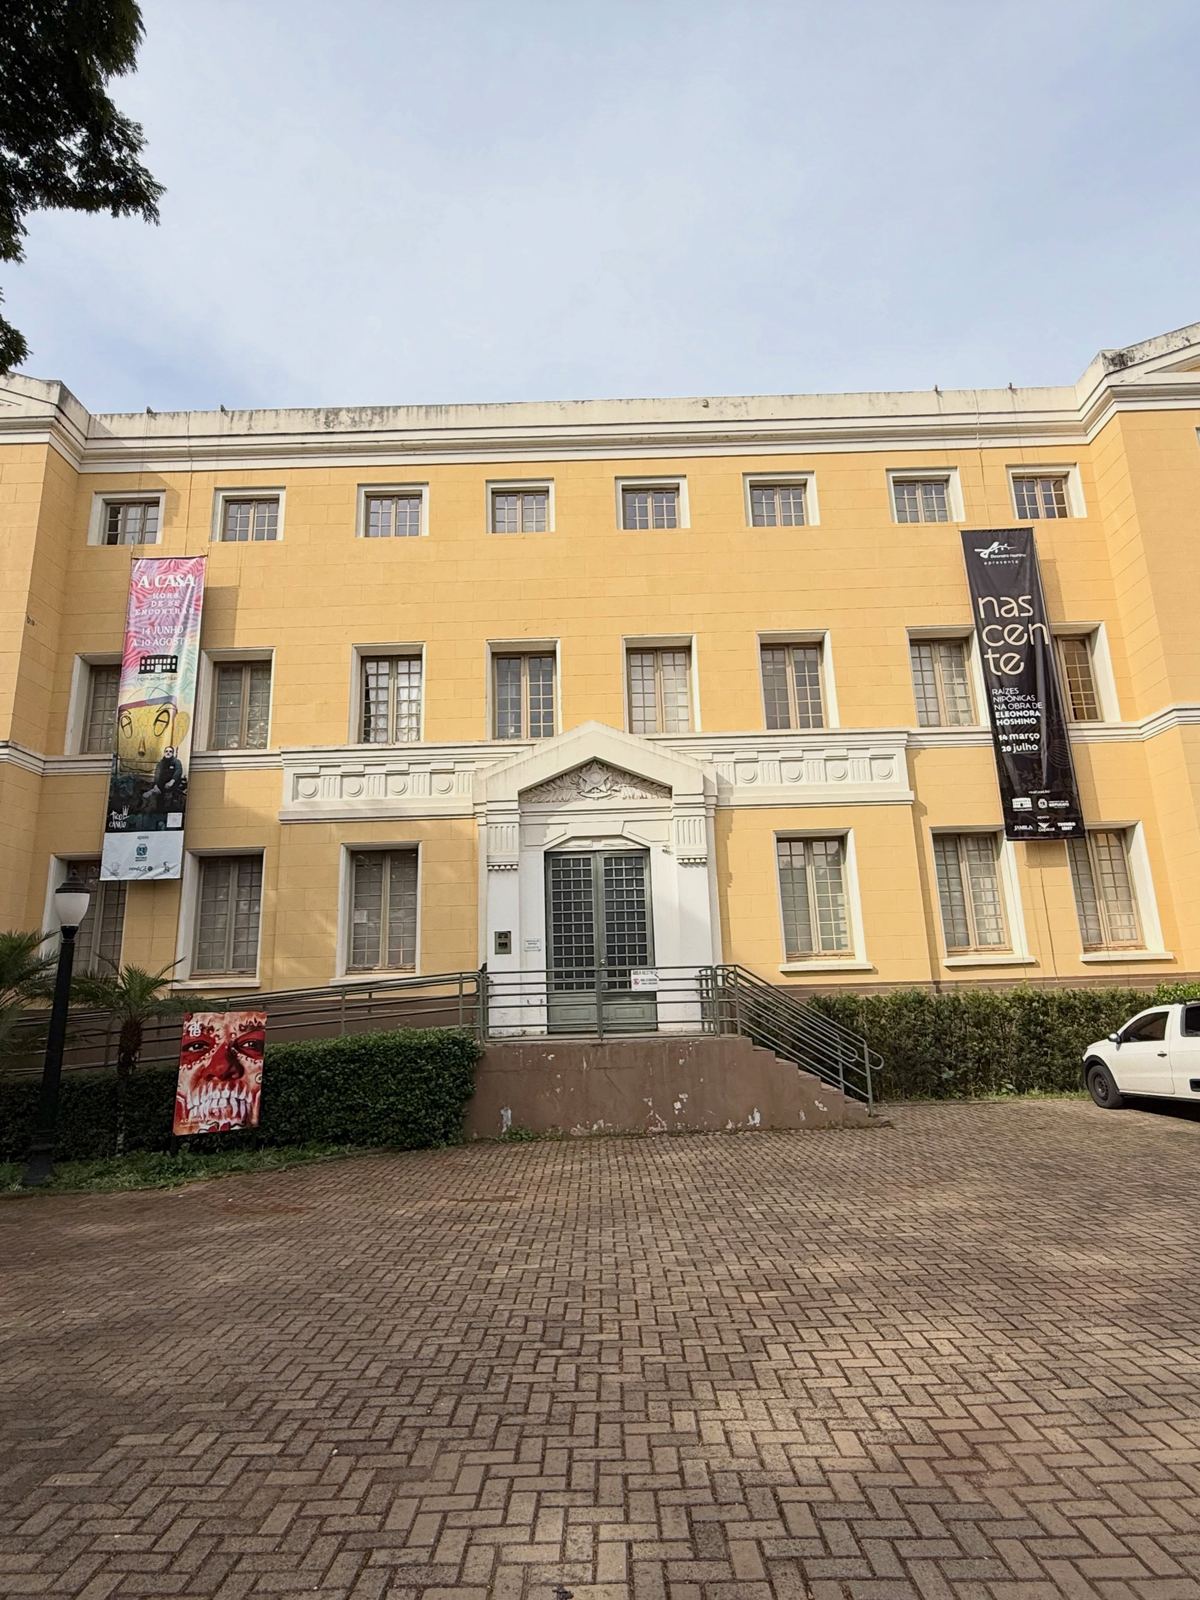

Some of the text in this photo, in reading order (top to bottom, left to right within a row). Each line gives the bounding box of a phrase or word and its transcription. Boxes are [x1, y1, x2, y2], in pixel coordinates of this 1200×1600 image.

[138, 574, 196, 588] A CASA
[978, 595, 1034, 619] nas
[153, 626, 184, 635] JUNHO
[982, 622, 1049, 647] cen
[984, 648, 1025, 675] te
[992, 687, 1019, 695] RAÍZES
[993, 694, 1036, 703] NIPÔNICAS
[994, 703, 1007, 711] NA
[1007, 702, 1031, 710] OBRA
[995, 710, 1041, 718] ELEONORA
[996, 717, 1037, 726] HOSHINO
[1009, 733, 1040, 741] março
[1012, 743, 1039, 754] julho
